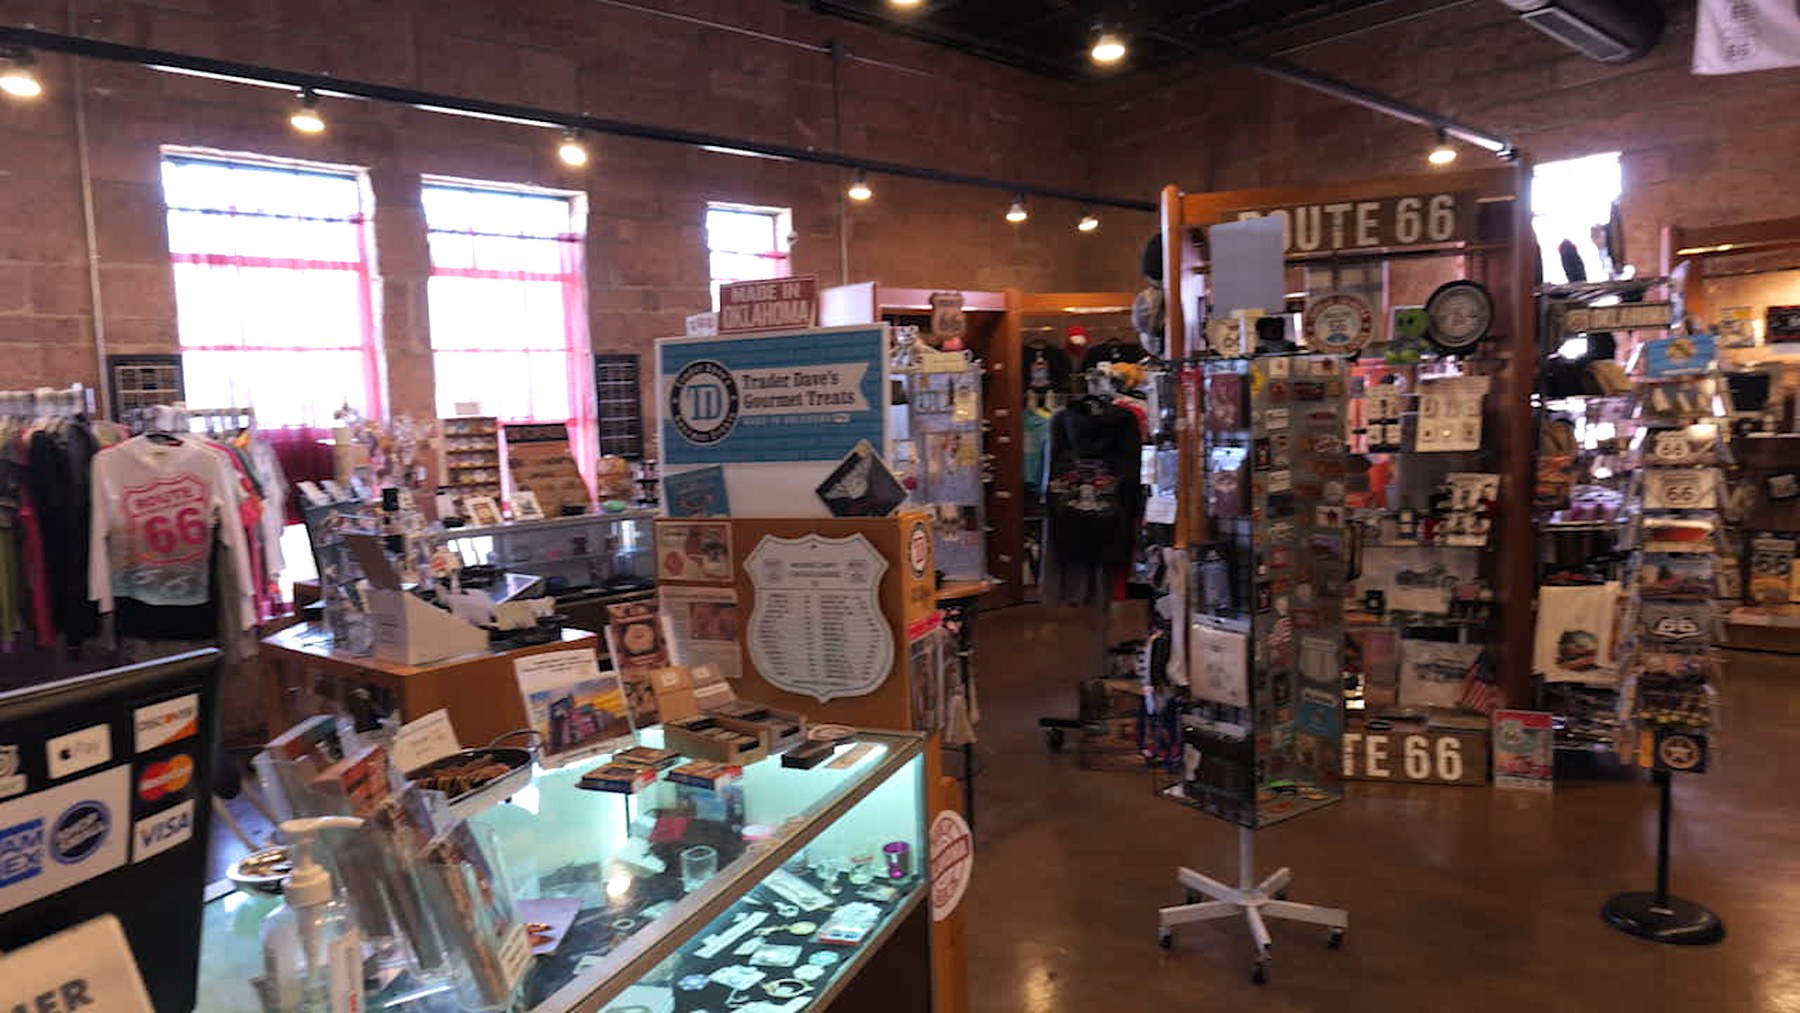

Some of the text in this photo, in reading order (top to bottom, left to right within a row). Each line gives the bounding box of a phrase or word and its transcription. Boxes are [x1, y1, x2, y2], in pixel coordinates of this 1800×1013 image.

[1395, 194, 1456, 244] 66
[731, 282, 800, 303] MADE IN
[723, 300, 810, 328] OKLAHOMA
[742, 373, 789, 389] Trader
[793, 370, 840, 388] Dave's
[742, 390, 856, 409] Gourmet Treats
[145, 507, 209, 554] 66
[1404, 734, 1462, 780] 66
[1, 829, 43, 853] AM
[138, 812, 190, 846] VISA
[3, 850, 43, 876] EX
